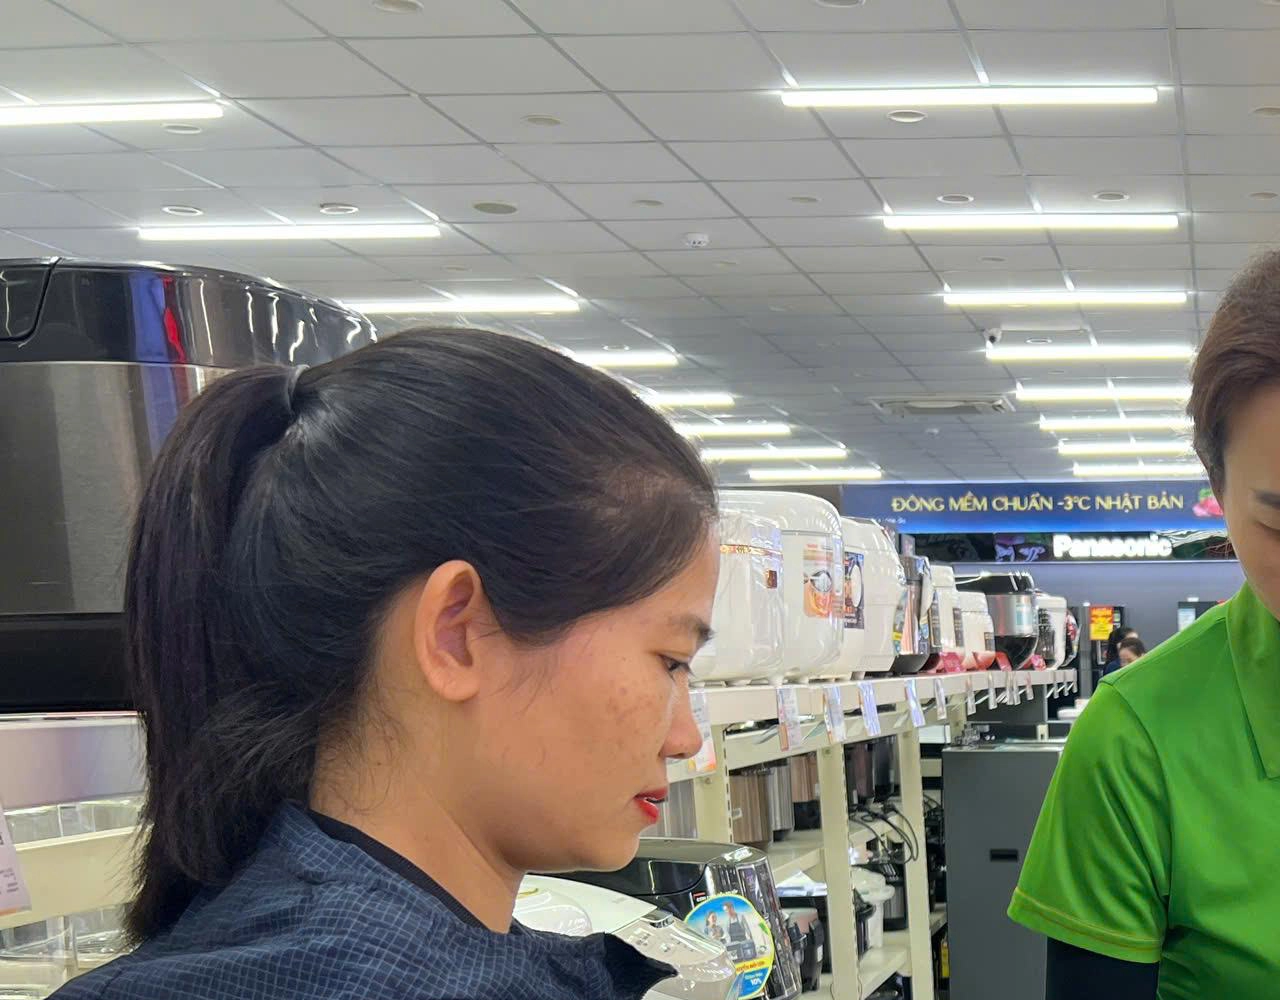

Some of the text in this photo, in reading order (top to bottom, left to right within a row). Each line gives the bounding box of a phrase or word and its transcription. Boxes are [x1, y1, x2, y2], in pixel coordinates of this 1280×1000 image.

[890, 494, 945, 513] ĐÔNG
[948, 490, 988, 513] MỀM
[991, 491, 1053, 512] CHUẨN
[1094, 492, 1142, 514] NHẬT
[1147, 490, 1184, 510] BẢN
[1052, 533, 1174, 558] Panasonic
